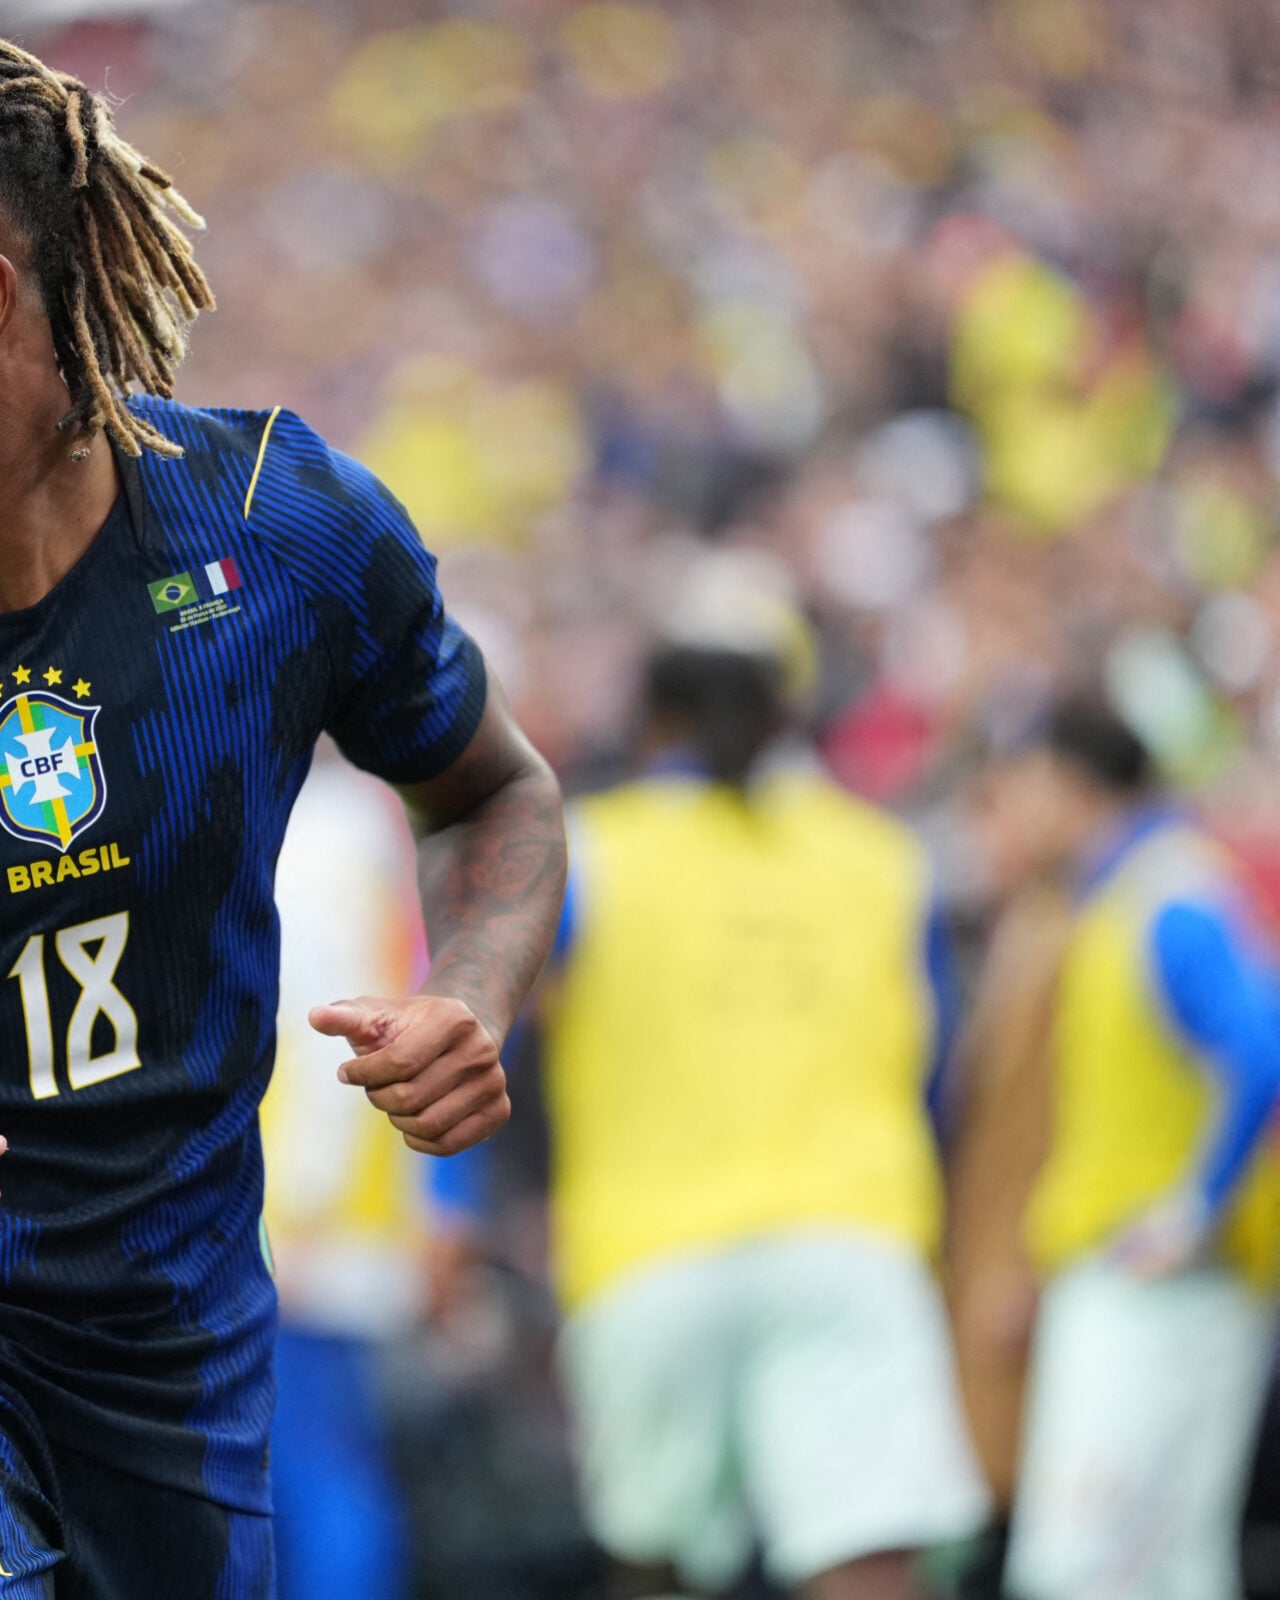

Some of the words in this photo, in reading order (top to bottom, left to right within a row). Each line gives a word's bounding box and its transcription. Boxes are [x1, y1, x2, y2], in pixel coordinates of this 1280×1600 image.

[20, 752, 64, 778] CBF
[6, 842, 131, 894] BRASIL
[6, 909, 143, 1101] 18
